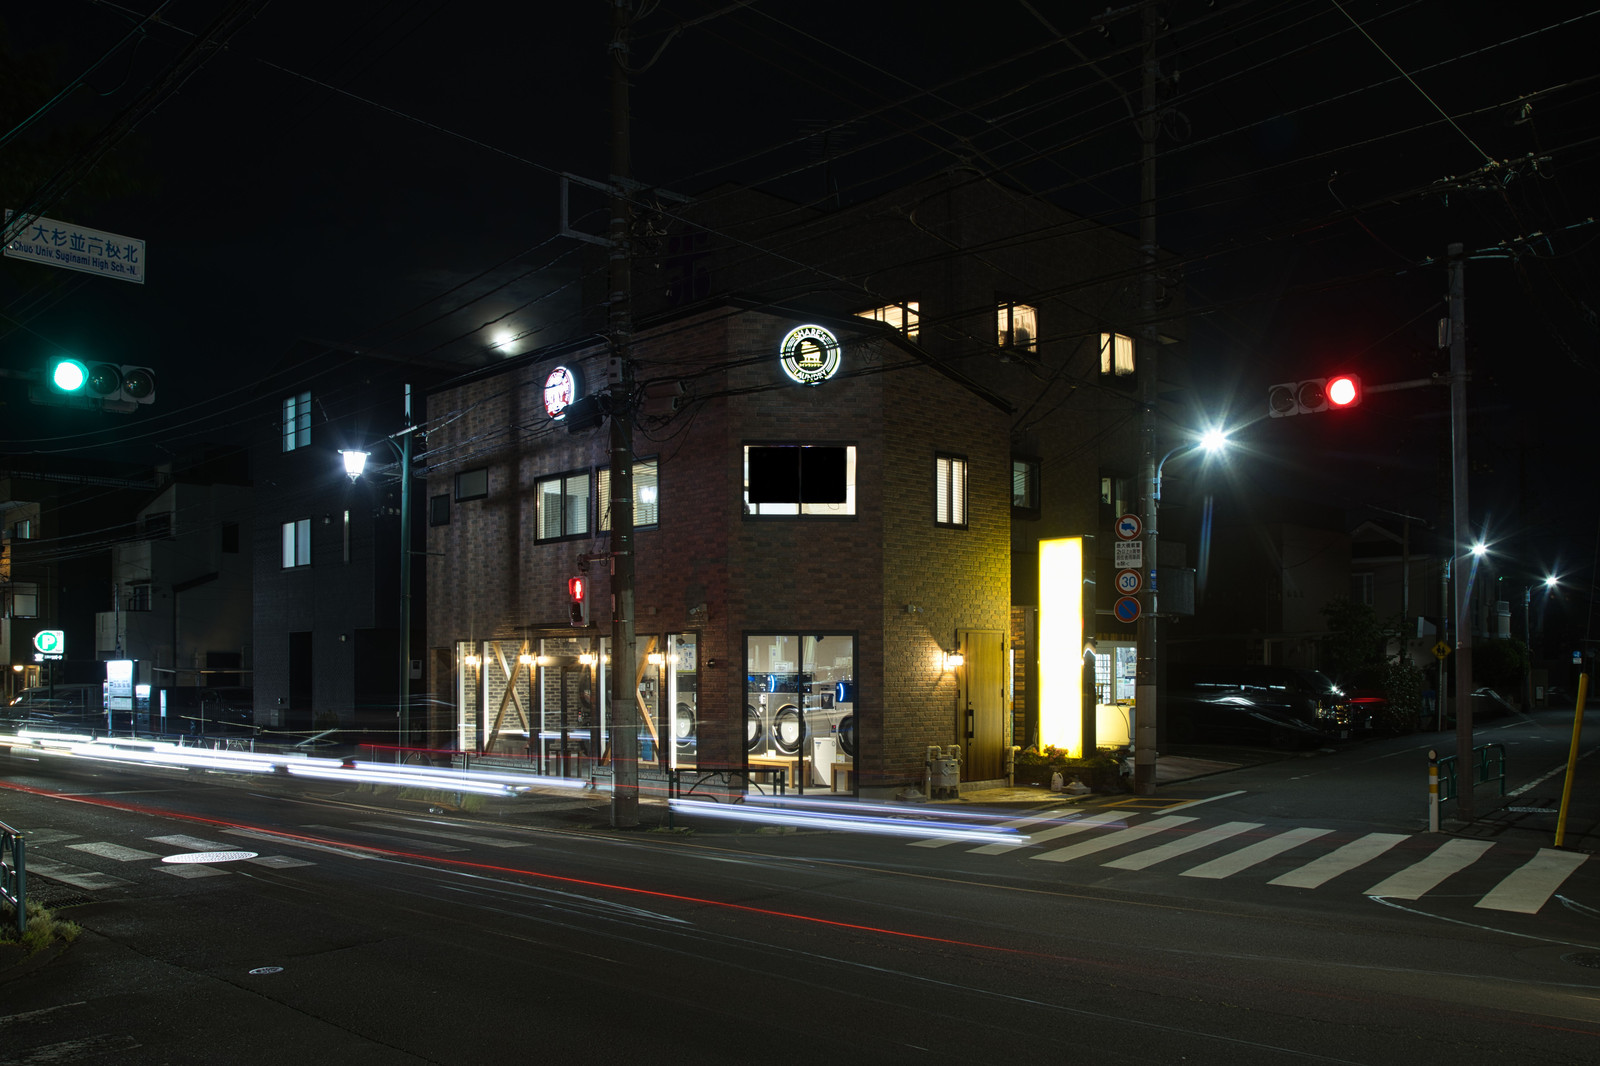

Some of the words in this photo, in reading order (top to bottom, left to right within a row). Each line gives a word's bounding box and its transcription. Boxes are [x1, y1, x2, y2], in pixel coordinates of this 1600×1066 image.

[21, 223, 138, 263] 大杉並高校北
[13, 240, 33, 254] Chuo
[35, 245, 54, 258] Univ.
[55, 249, 91, 265] Suginami
[92, 257, 109, 271] High
[794, 328, 827, 339] SHARE'S
[794, 369, 827, 381] LAUNDRY
[1121, 576, 1136, 587] 30
[42, 634, 55, 649] P
